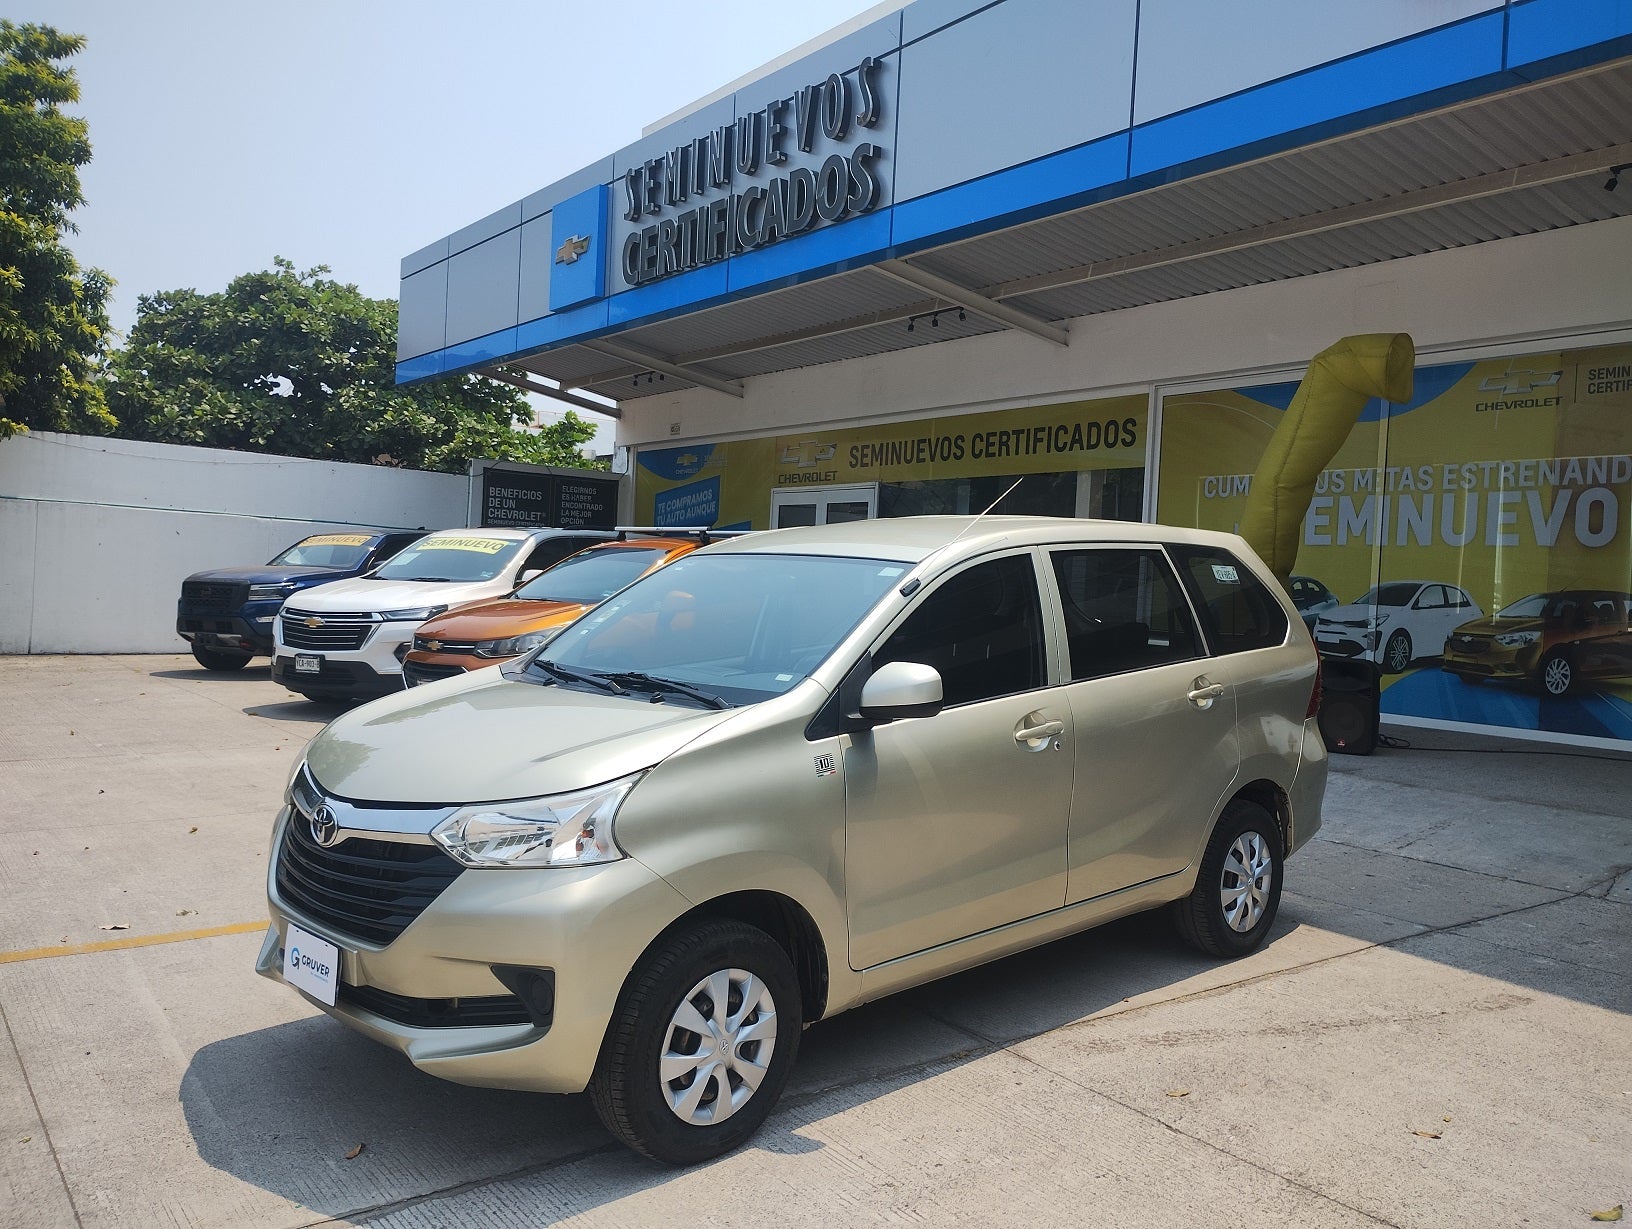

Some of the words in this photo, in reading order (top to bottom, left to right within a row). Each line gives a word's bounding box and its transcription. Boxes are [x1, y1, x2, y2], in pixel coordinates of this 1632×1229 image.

[623, 56, 881, 222] SEMINUEVOS
[621, 143, 881, 286] CERTIFICADOS
[1587, 365, 1632, 381] SEMIN
[1475, 396, 1563, 412] CHEVROLET
[849, 434, 965, 468] SEMINUEVOS
[971, 418, 1138, 459] CERTIFICADOS
[778, 470, 838, 485] CHEVROLET
[1203, 474, 1251, 498] CUM
[1314, 470, 1346, 494] US
[489, 486, 543, 501] BENEFICIOS
[562, 485, 597, 495] ELEGIRNOS
[489, 497, 501, 508] DE
[503, 498, 516, 509] UN
[561, 501, 603, 511] ENCONTRADO
[666, 489, 713, 511] COMPRAMOS
[570, 509, 592, 519] MEJOR
[666, 509, 685, 523] AUTO
[685, 500, 717, 520] AUNQUE
[1304, 487, 1619, 548] EMINUEVO
[302, 535, 368, 545] SEMINUEVO
[422, 539, 505, 551] SEMINUEVO
[301, 955, 329, 977] GRUVER
